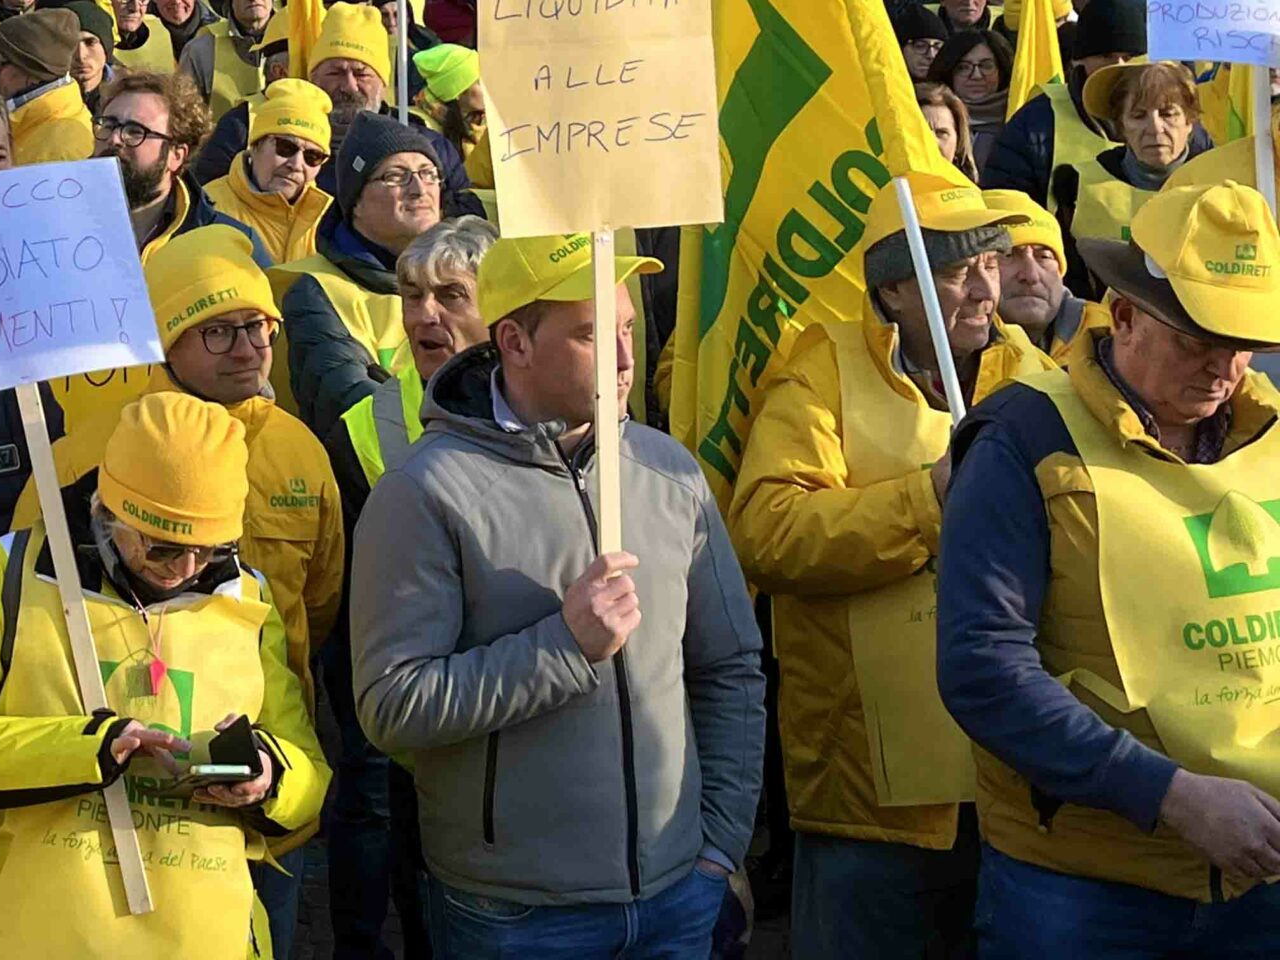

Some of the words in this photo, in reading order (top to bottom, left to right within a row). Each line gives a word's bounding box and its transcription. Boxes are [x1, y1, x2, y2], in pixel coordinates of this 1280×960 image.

[534, 60, 645, 91] ALLE
[500, 113, 706, 163] IMPRESE
[166, 288, 239, 332] COLDIRETTI
[122, 499, 193, 535] COLDIRETTI
[77, 798, 191, 836] PIEONTE
[160, 849, 185, 867] del
